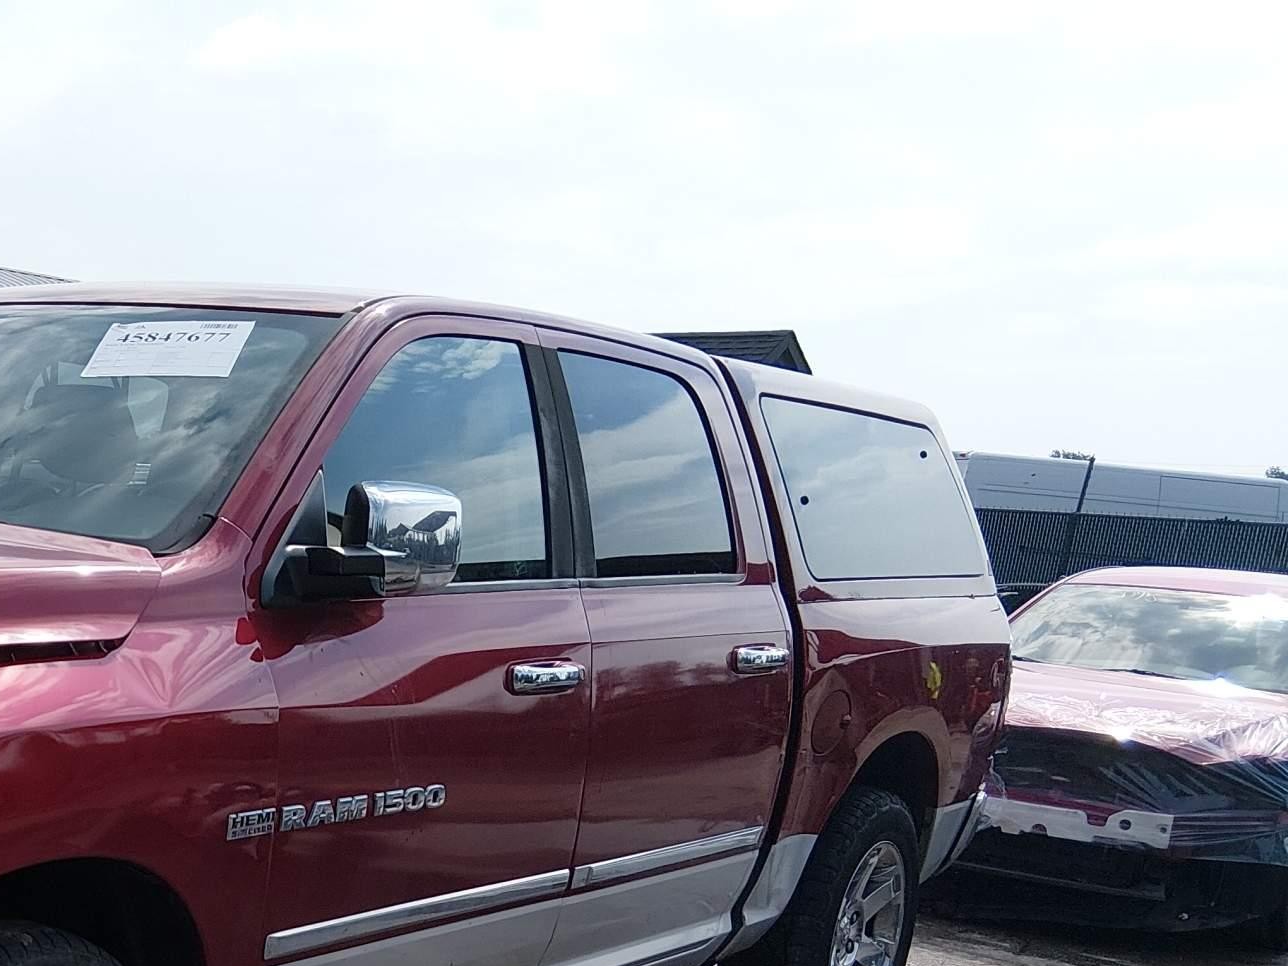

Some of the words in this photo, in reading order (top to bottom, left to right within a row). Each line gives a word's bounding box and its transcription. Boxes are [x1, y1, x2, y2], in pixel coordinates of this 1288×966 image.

[116, 332, 230, 343] 45847677
[279, 795, 368, 832] RAM
[374, 783, 446, 817] 1500
[231, 811, 275, 829] HEMI
